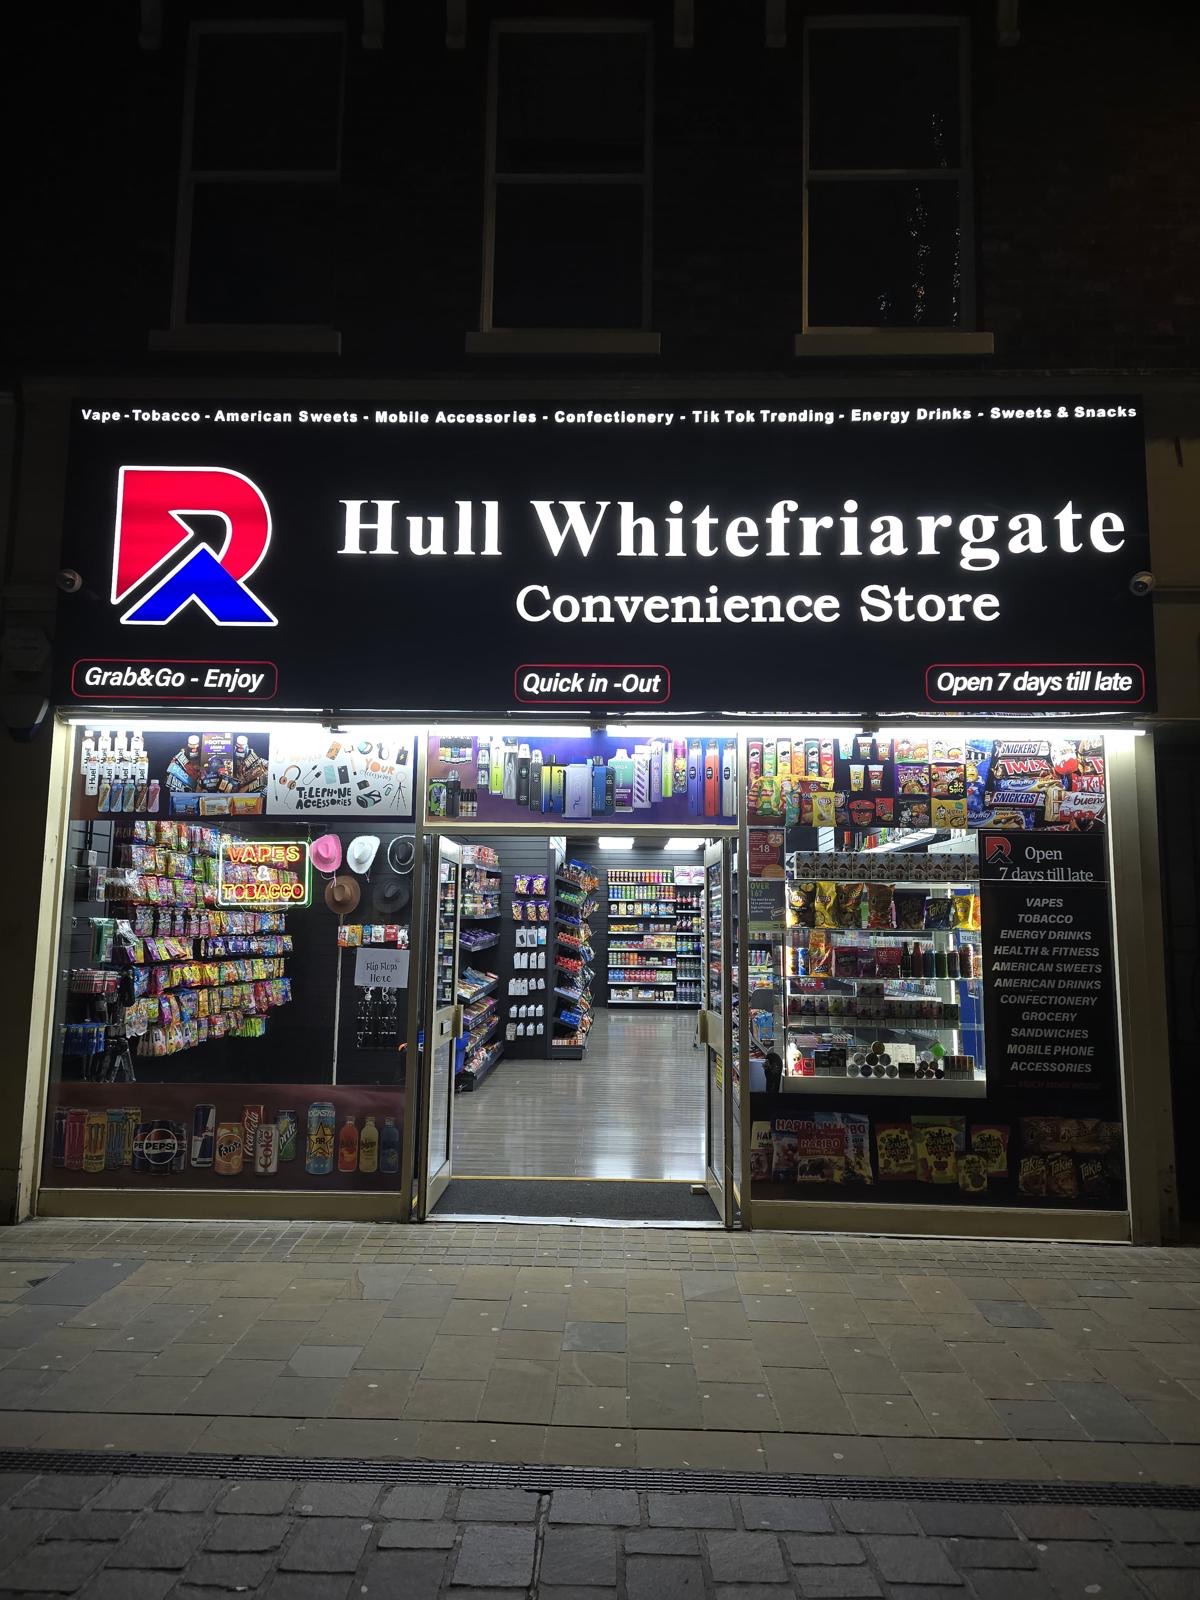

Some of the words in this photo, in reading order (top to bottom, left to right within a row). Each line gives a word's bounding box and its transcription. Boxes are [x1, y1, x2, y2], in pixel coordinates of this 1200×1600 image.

[82, 409, 121, 424] Vape
[132, 410, 201, 422] Tobacco
[214, 410, 292, 423] American
[299, 411, 358, 423] Sweets
[376, 411, 430, 424] Mobile
[435, 411, 537, 424] Accessories
[555, 411, 675, 426] Confectionery
[692, 411, 720, 423] Tik
[725, 410, 756, 423] Tok
[760, 410, 835, 425] Trending
[852, 409, 911, 425] Energy
[917, 408, 972, 421] Drinks
[991, 407, 1052, 420] Sweets
[1057, 407, 1069, 419] &
[1075, 406, 1137, 418] Snacks
[337, 499, 503, 557] Hull
[530, 499, 1127, 572] Whitefriargate
[515, 584, 841, 624] Convenience
[859, 584, 1001, 624] Store
[84, 666, 186, 689] Grab&Go
[203, 667, 266, 695] Enjoy
[522, 672, 585, 695] Quick
[587, 672, 609, 693] in
[936, 671, 994, 697] Open
[997, 671, 1011, 693] 7
[1013, 671, 1063, 697] days
[1066, 670, 1092, 692] till
[1094, 670, 1133, 692] late
[1001, 743, 1038, 754] SNICKERS
[364, 759, 394, 776] YOUR
[998, 758, 1050, 775] TWIX
[89, 768, 97, 785] Huel
[993, 792, 1037, 804] SNICKERS
[769, 834, 782, 844] 25
[227, 845, 301, 863] VAPES
[759, 844, 770, 853] 18
[1025, 846, 1063, 864] Open
[256, 865, 270, 881] &
[999, 867, 1009, 881] 7
[1011, 867, 1044, 882] days
[1047, 867, 1065, 882] till
[1067, 867, 1094, 882] late
[222, 883, 304, 900] TOBACCO
[750, 882, 769, 890] OVER
[1025, 897, 1064, 908] VAPES
[1017, 913, 1074, 924] TOBACCO
[999, 929, 1047, 940] ENERGY
[1047, 930, 1093, 941] DRINKS
[993, 945, 1039, 956] HEALTH
[1040, 947, 1050, 957] &
[1051, 946, 1101, 958] FITNESS
[992, 961, 1054, 973] AMERICAN
[1055, 962, 1103, 974] SWEETS
[993, 977, 1056, 989] AMERICAN
[1057, 979, 1103, 990] DRINKS
[1000, 994, 1099, 1007] CONFECTIONERY
[1021, 1011, 1078, 1022] GROCERY
[1010, 1027, 1090, 1039] SANDWICHES
[1006, 1044, 1052, 1055] MOBILE
[1053, 1045, 1096, 1057] PHONE
[1010, 1061, 1093, 1073] ACCESSORIES
[145, 1142, 176, 1151] PEPSI
[800, 1137, 841, 1148] HARIBO
[1080, 1160, 1104, 1184] Takis
